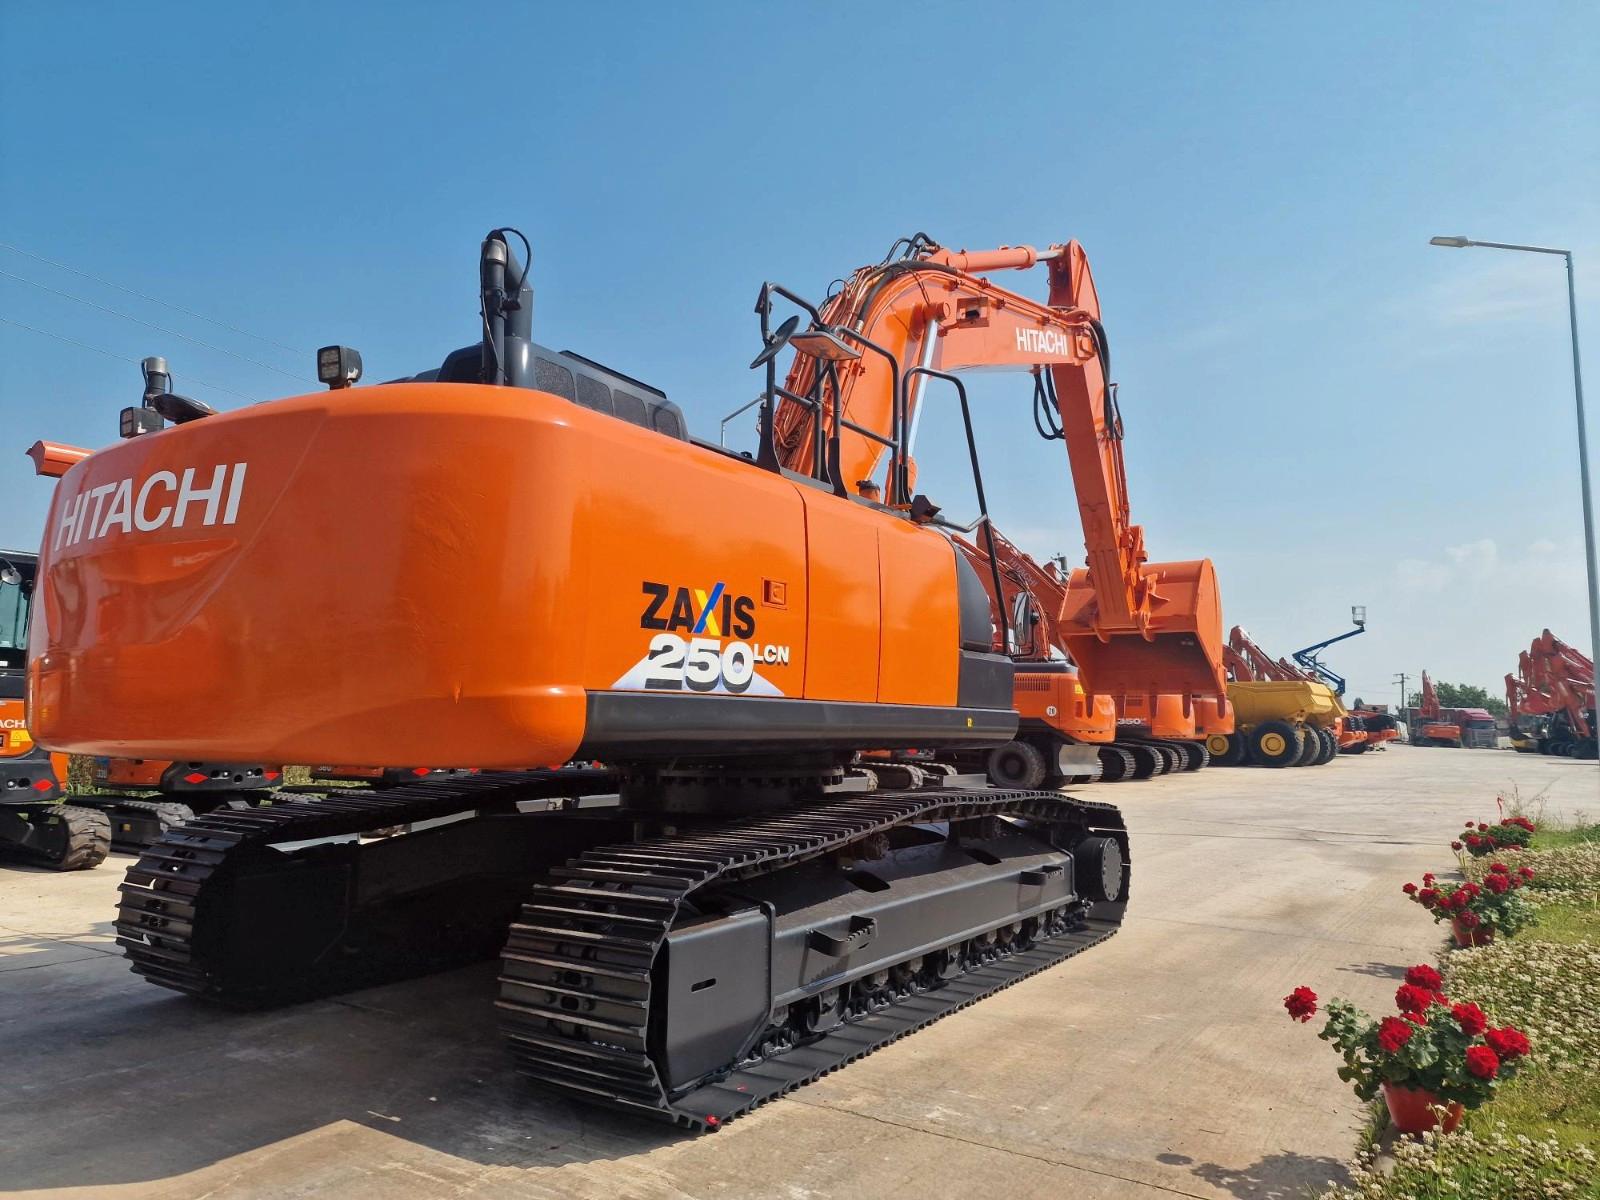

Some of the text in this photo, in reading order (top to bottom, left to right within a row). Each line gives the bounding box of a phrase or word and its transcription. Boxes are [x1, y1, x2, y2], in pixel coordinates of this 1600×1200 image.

[1016, 327, 1068, 356] HITACHI
[55, 463, 247, 552] HITACHI
[641, 581, 756, 640] ZAXIS
[645, 633, 790, 694] 250 LCN
